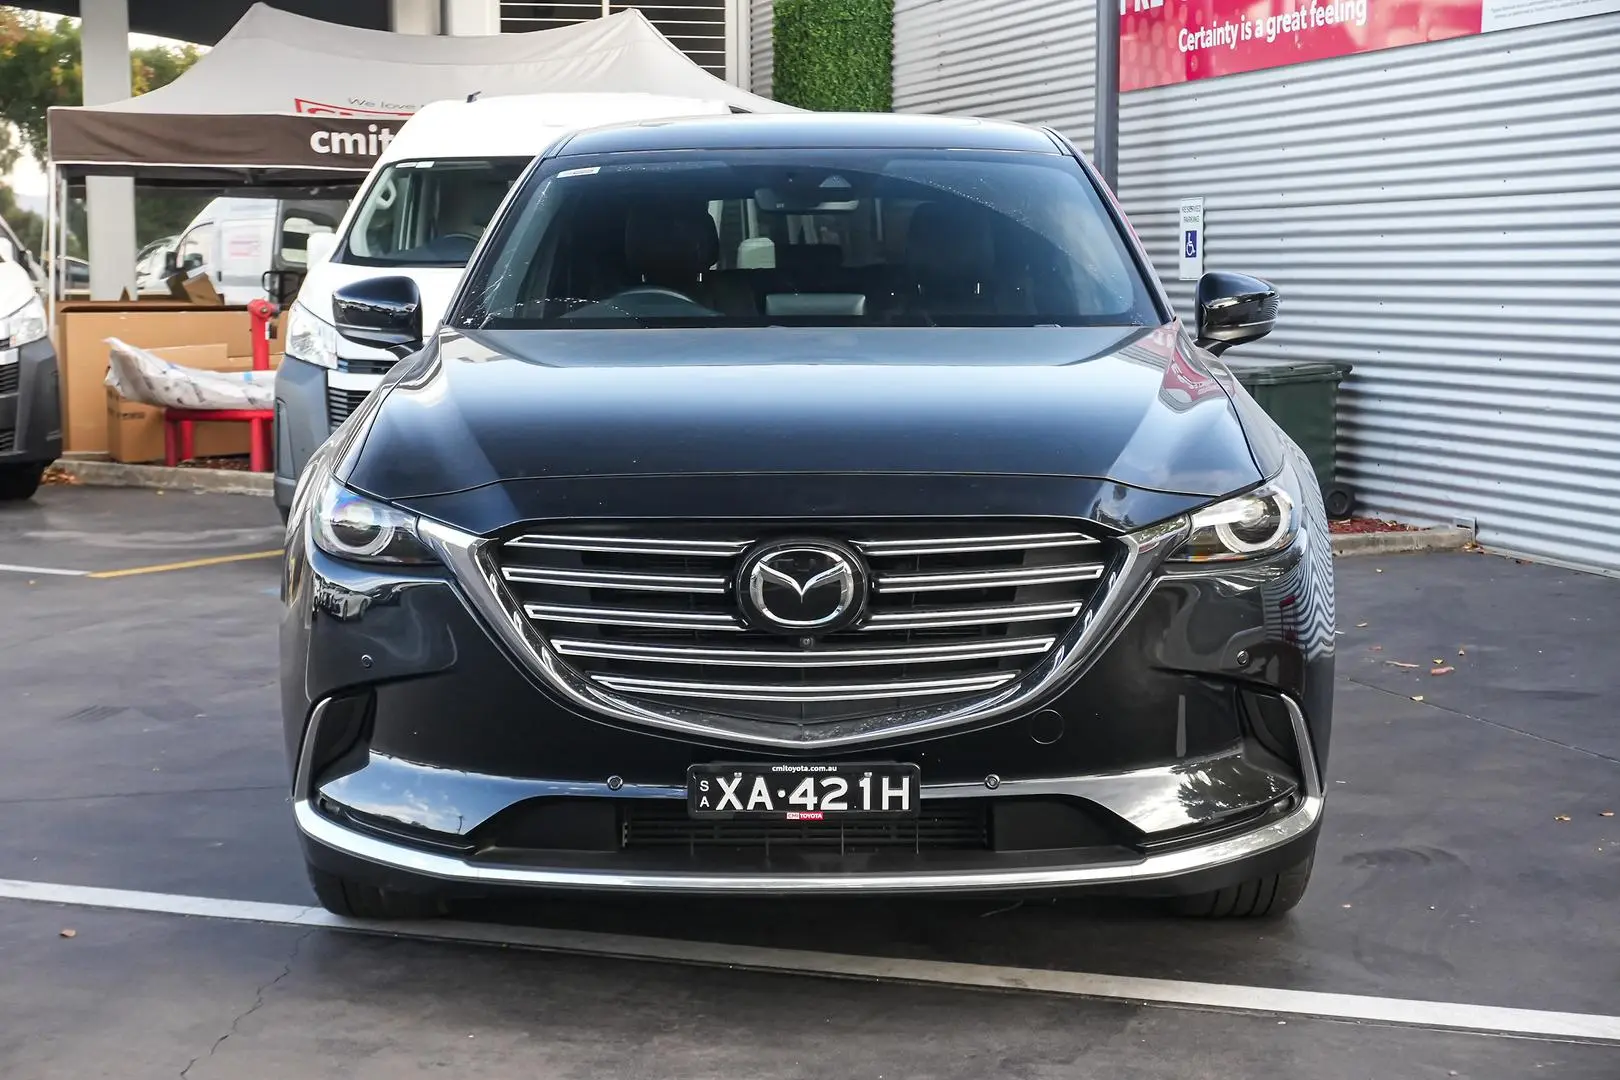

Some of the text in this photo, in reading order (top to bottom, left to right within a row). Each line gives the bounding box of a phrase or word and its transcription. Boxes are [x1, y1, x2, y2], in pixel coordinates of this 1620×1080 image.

[1178, 0, 1367, 53] Certainty is a great feeling
[348, 97, 416, 110] We love
[771, 764, 838, 774] cmitoyota.com.au
